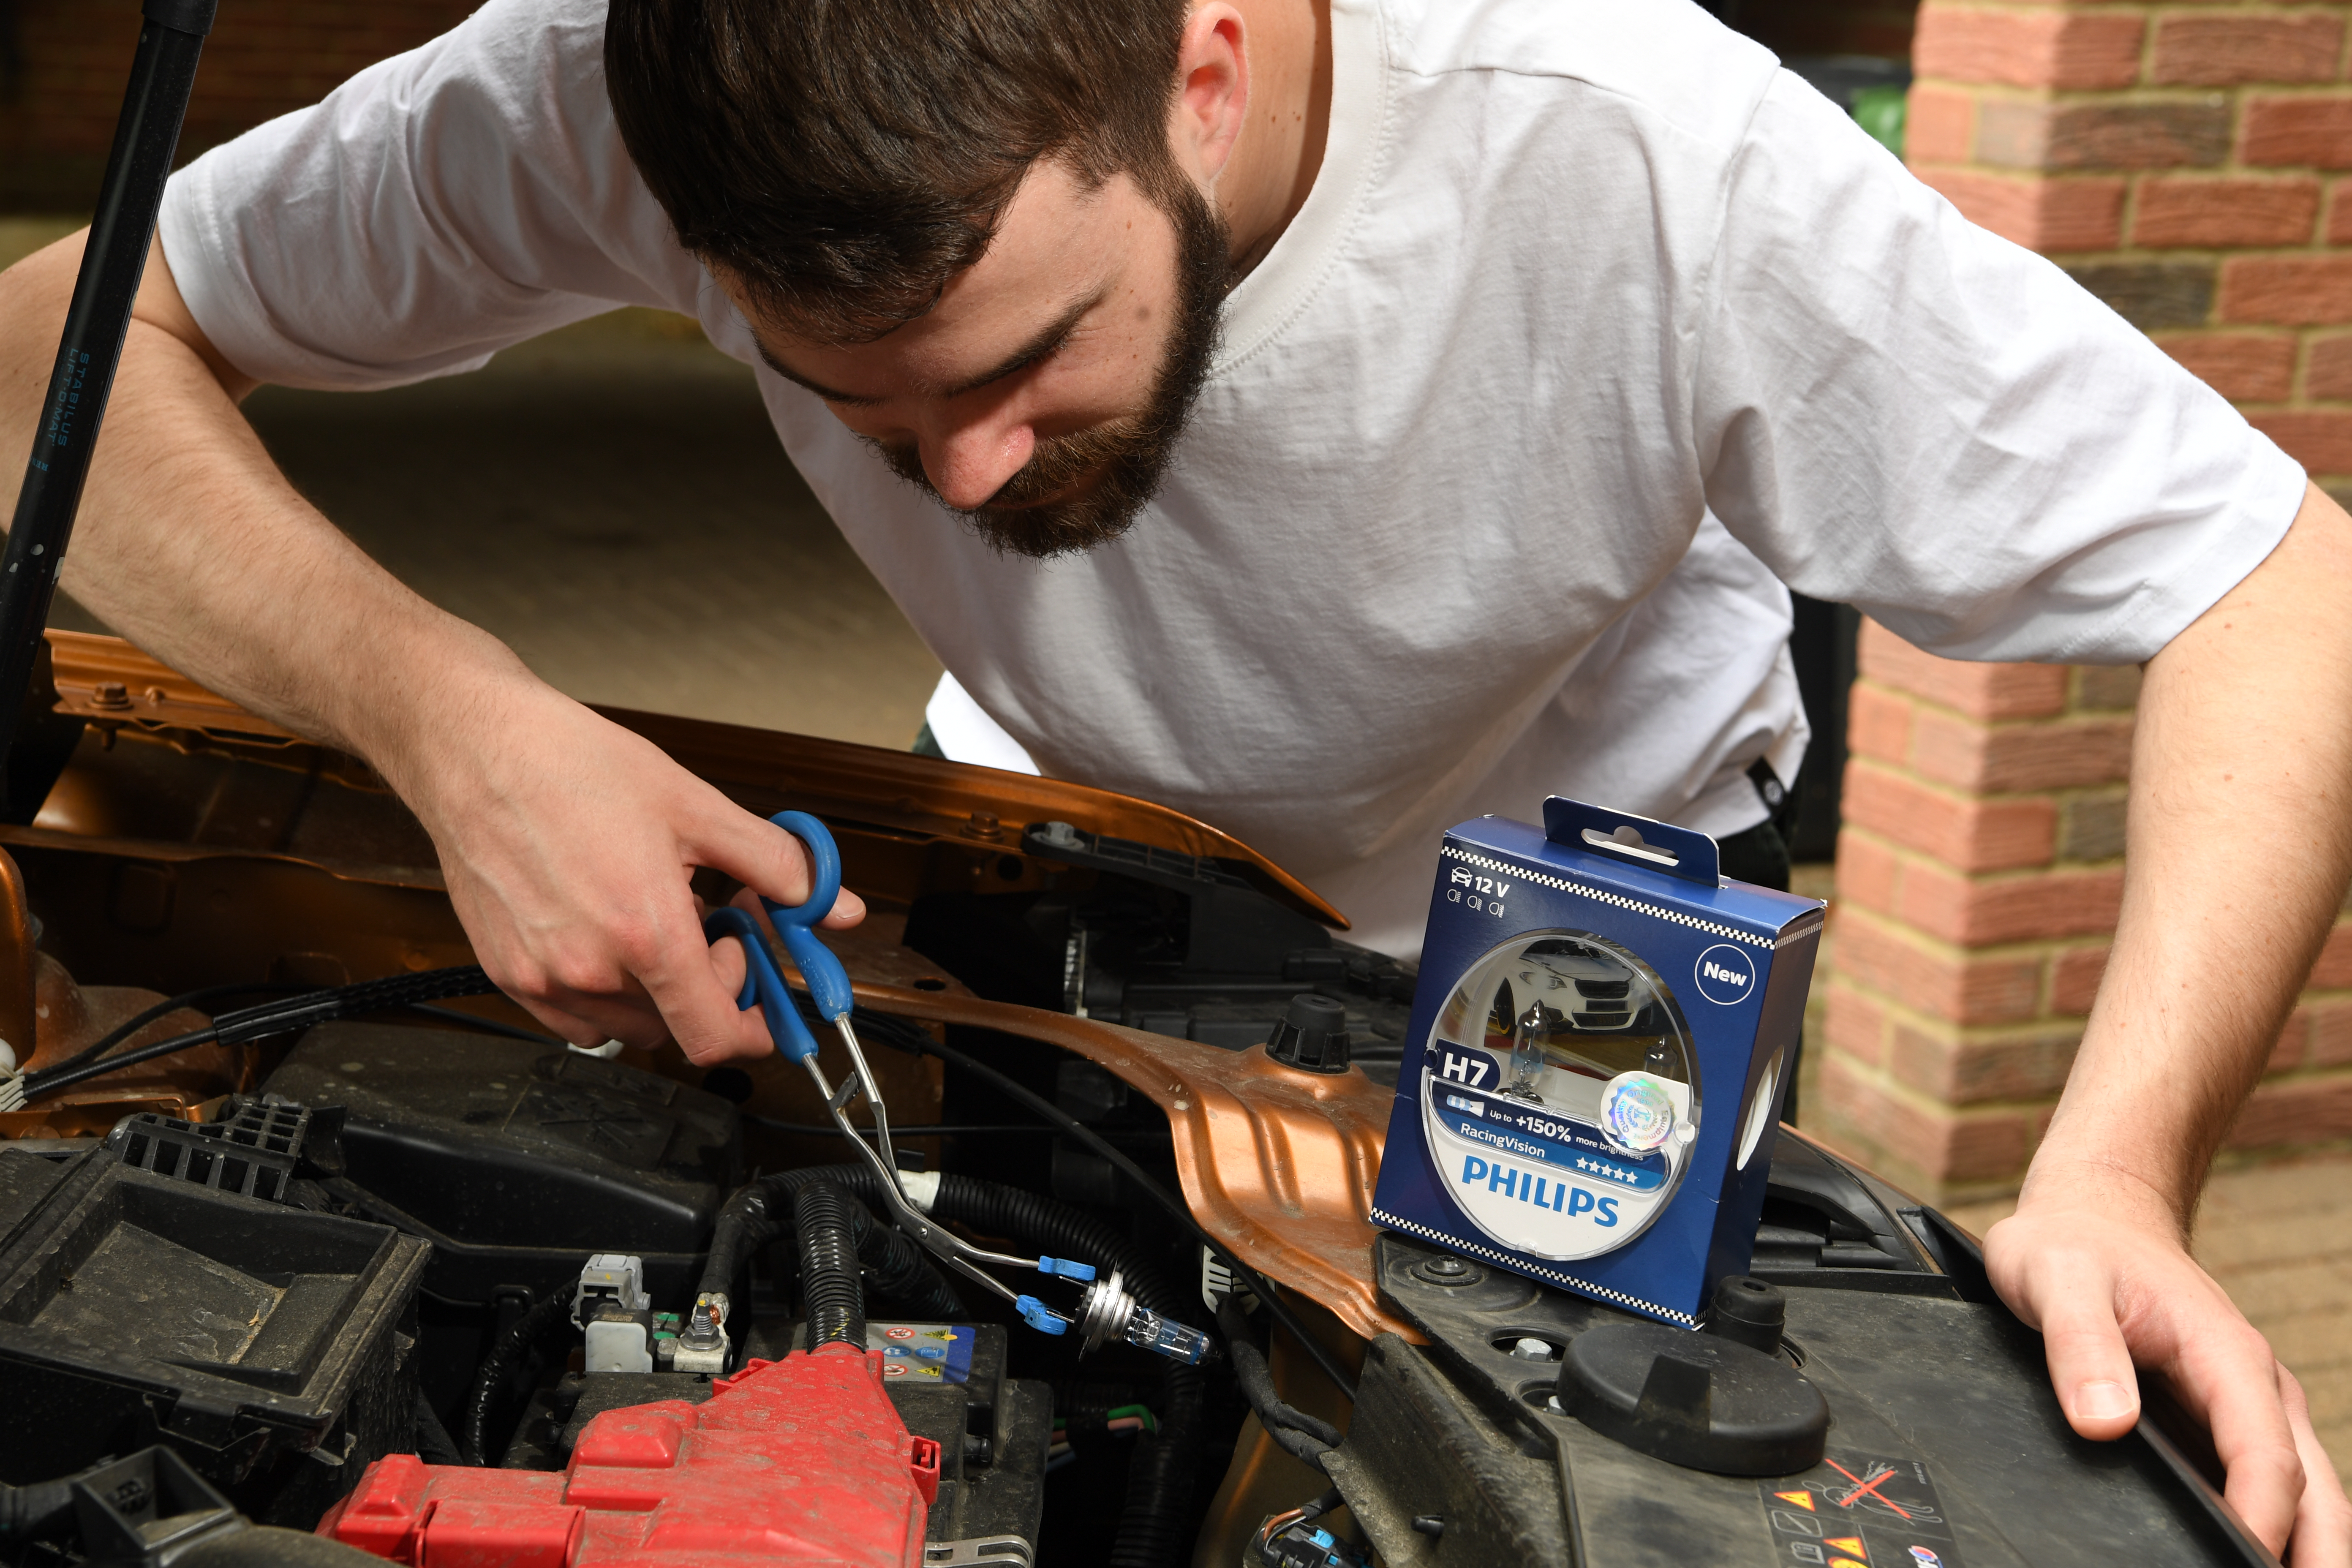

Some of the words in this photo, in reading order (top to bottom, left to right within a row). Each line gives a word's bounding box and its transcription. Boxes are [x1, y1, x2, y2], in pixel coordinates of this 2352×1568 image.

[58, 352, 89, 446] STABILUS
[1475, 877, 1493, 894] 12
[1497, 882, 1510, 898] V
[1704, 961, 1747, 986] New
[1443, 1052, 1489, 1086] H7
[1627, 1089, 1664, 1105] Original
[1490, 1109, 1502, 1120] Up
[1503, 1113, 1512, 1122] to
[1516, 1116, 1571, 1142] +150%
[1576, 1136, 1598, 1148] more
[1616, 1099, 1629, 1133] Quality
[1633, 1110, 1669, 1141] Equipment
[1461, 1122, 1545, 1158] RacingVision
[1462, 1154, 1619, 1228] PHILIPS
